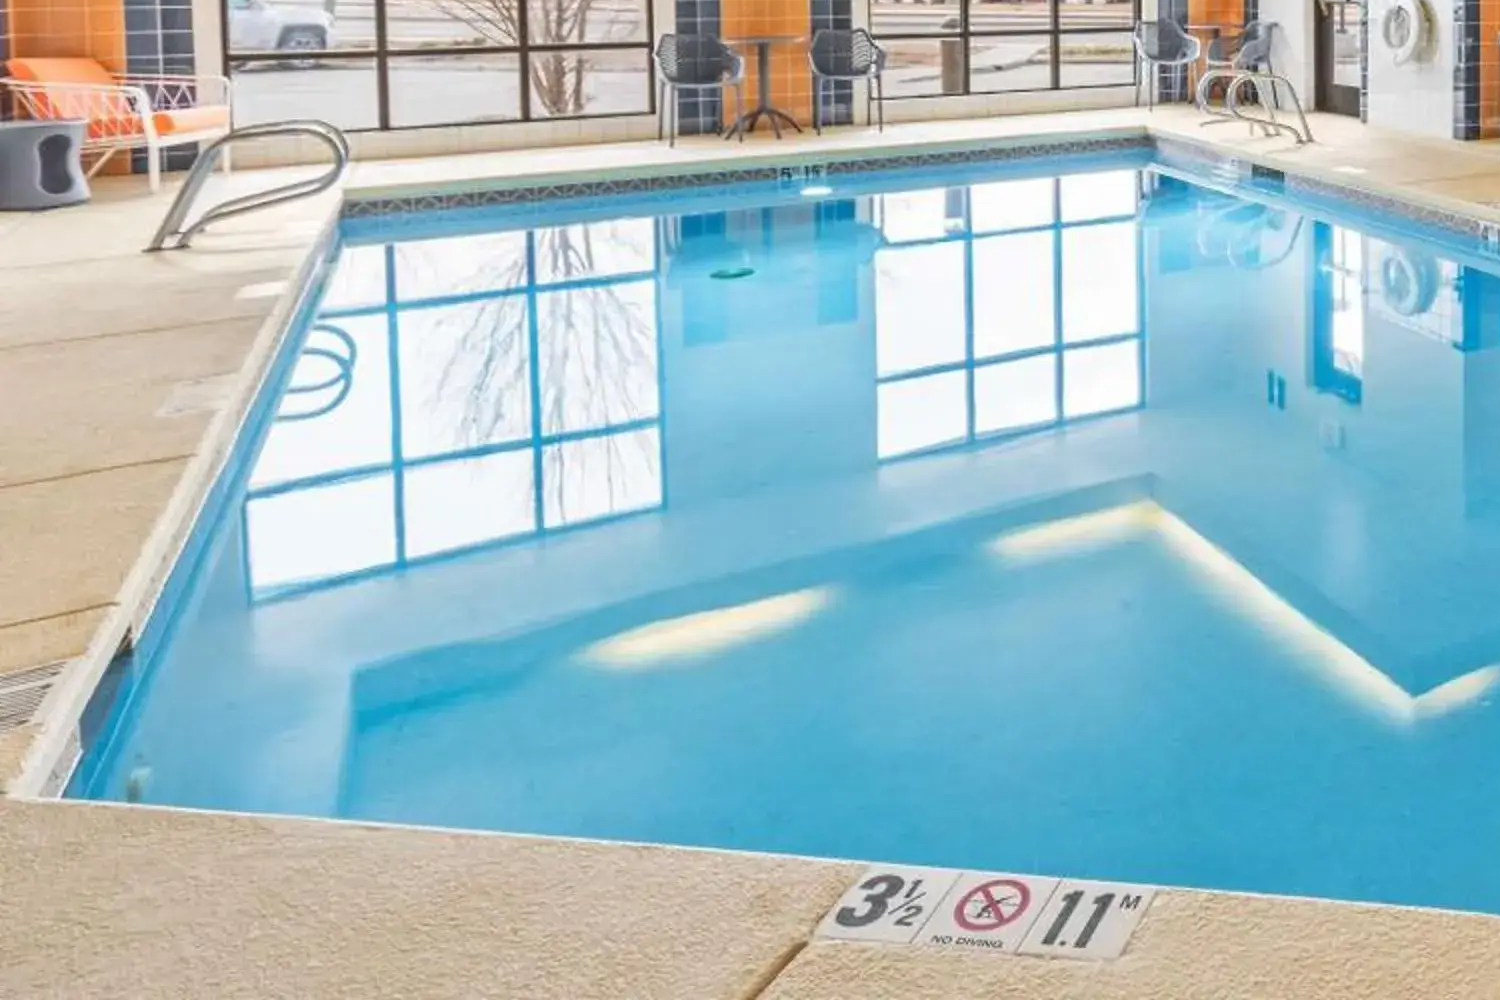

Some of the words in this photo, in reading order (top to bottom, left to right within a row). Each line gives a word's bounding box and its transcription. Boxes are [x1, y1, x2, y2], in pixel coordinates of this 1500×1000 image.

[1040, 890, 1116, 949] 1.1
[1119, 894, 1143, 910] M
[930, 934, 953, 946] NO
[955, 936, 1005, 949] DIVING
